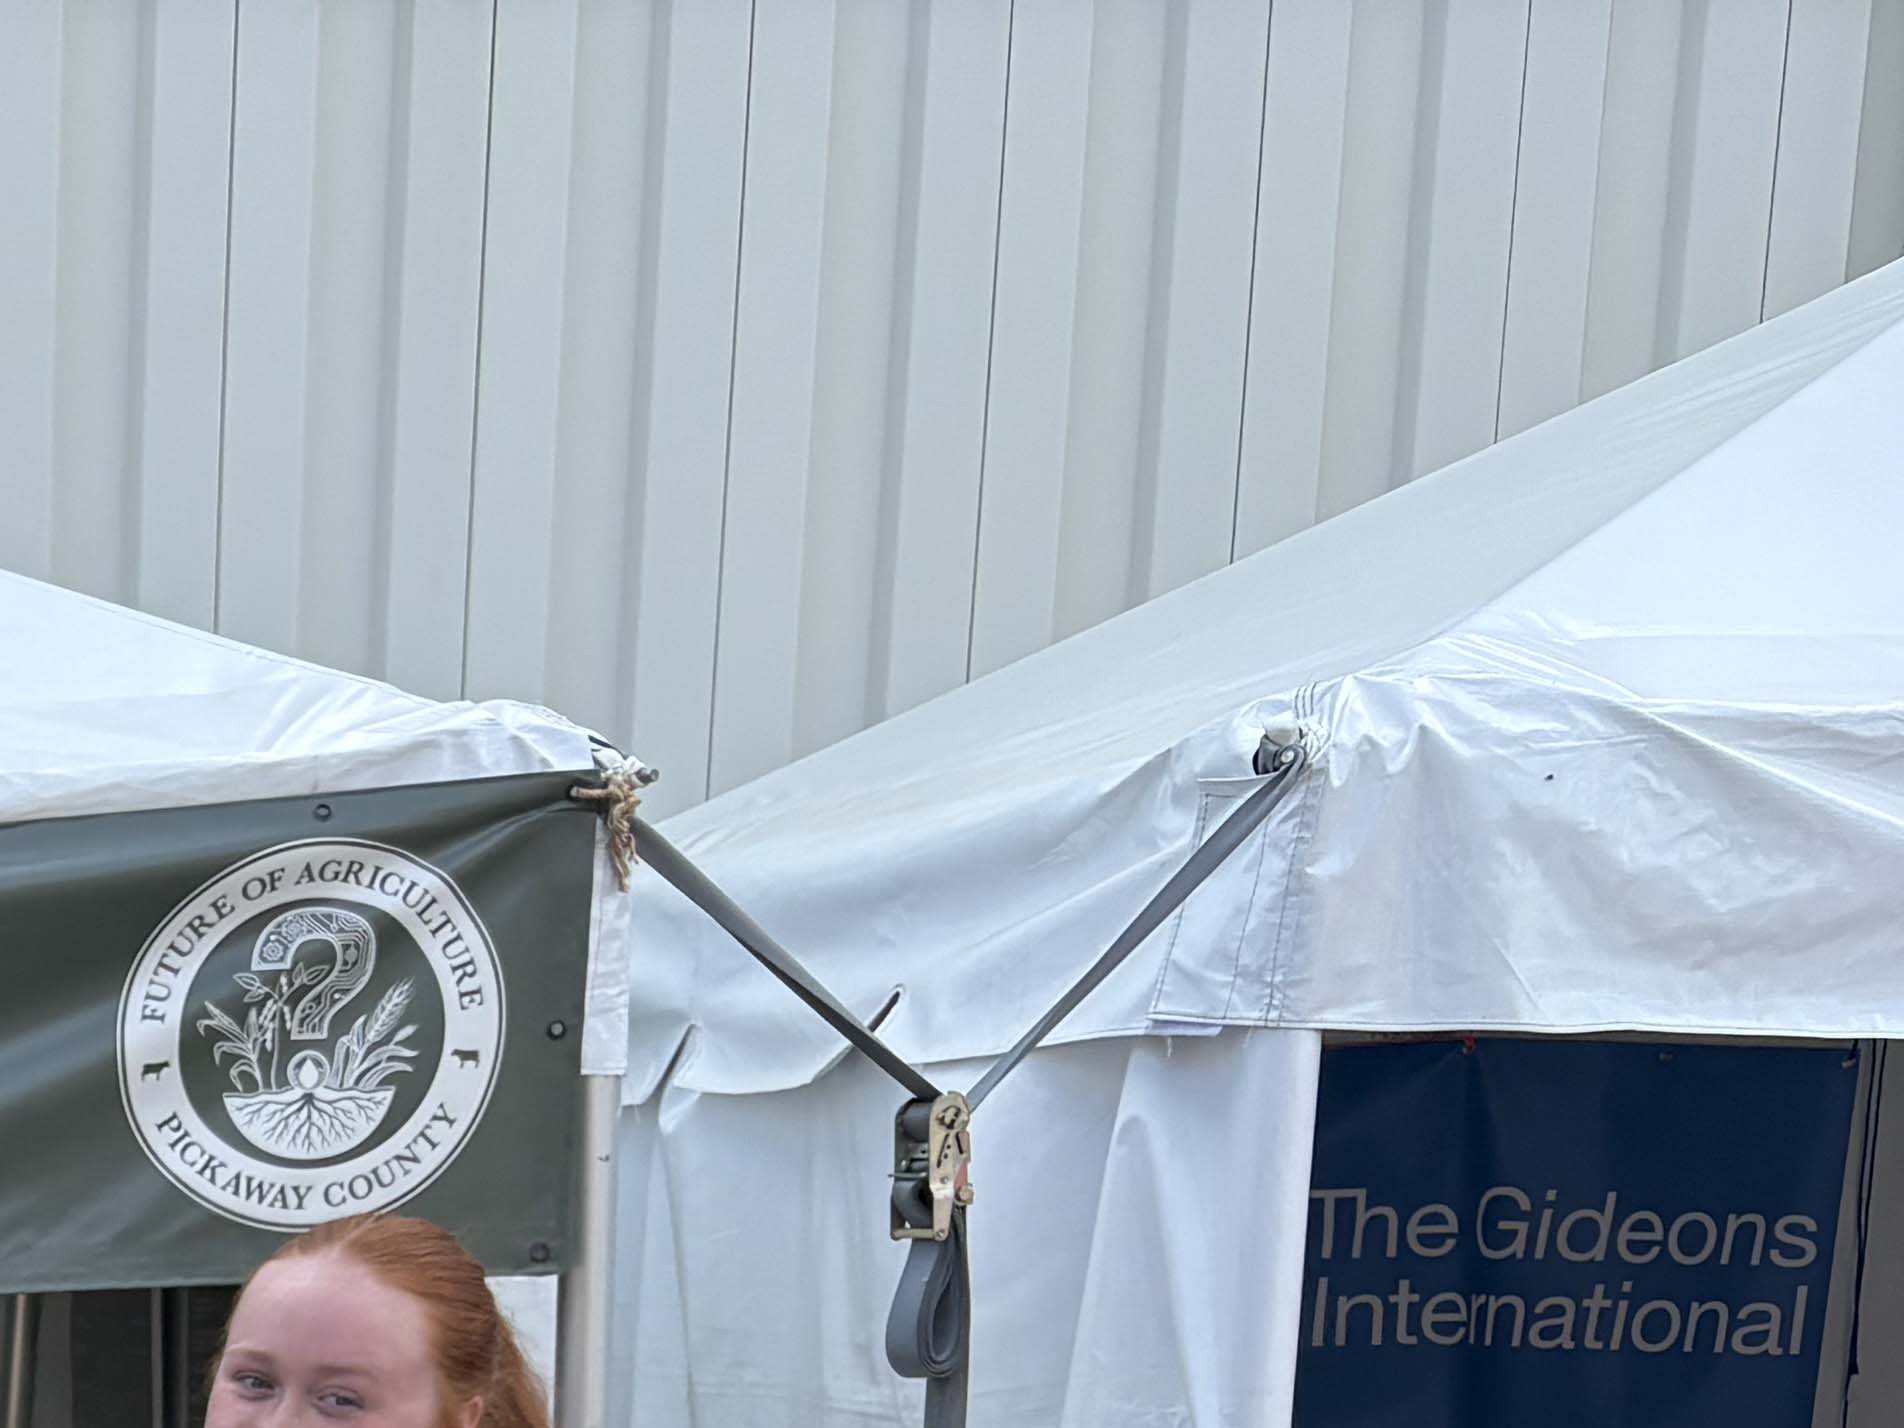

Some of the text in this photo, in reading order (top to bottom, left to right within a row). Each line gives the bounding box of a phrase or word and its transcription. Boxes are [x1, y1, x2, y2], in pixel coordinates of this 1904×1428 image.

[141, 858, 485, 1024] FUTURE OF AGRICULTURE
[155, 1103, 460, 1211] PICKAWAY COUNTY
[1310, 1184, 1818, 1269] The Gideons
[1311, 1276, 1808, 1356] International
